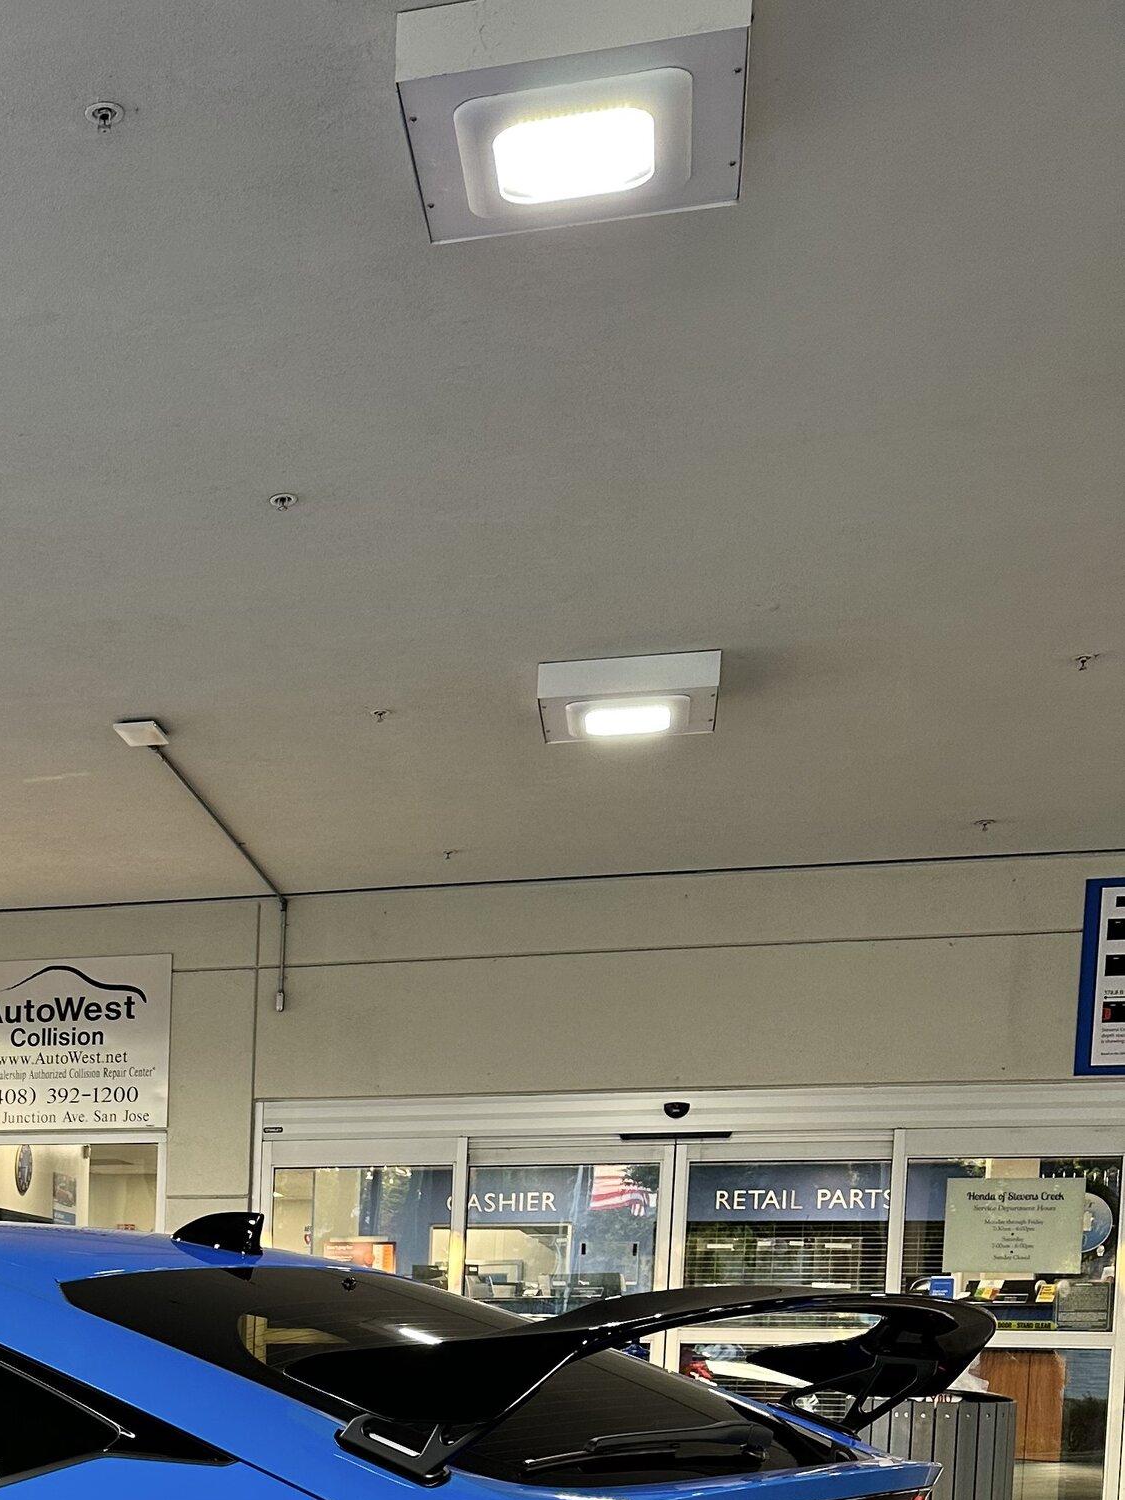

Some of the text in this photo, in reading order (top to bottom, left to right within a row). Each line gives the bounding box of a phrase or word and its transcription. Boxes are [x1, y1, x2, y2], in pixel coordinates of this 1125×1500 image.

[10, 1027, 104, 1047] Collision
[29, 1069, 67, 1079] Authorized
[69, 1068, 101, 1079] Collision
[103, 1067, 127, 1079] Repair
[46, 1086, 139, 1104] 392-1200
[1, 1110, 56, 1124] Junction
[63, 1111, 88, 1124] Ave.
[93, 1110, 117, 1123] San
[122, 1109, 150, 1123] Jose
[715, 1188, 891, 1210] RETAIL PARTS
[967, 1191, 1065, 1203] Honda of Stevens Creek
